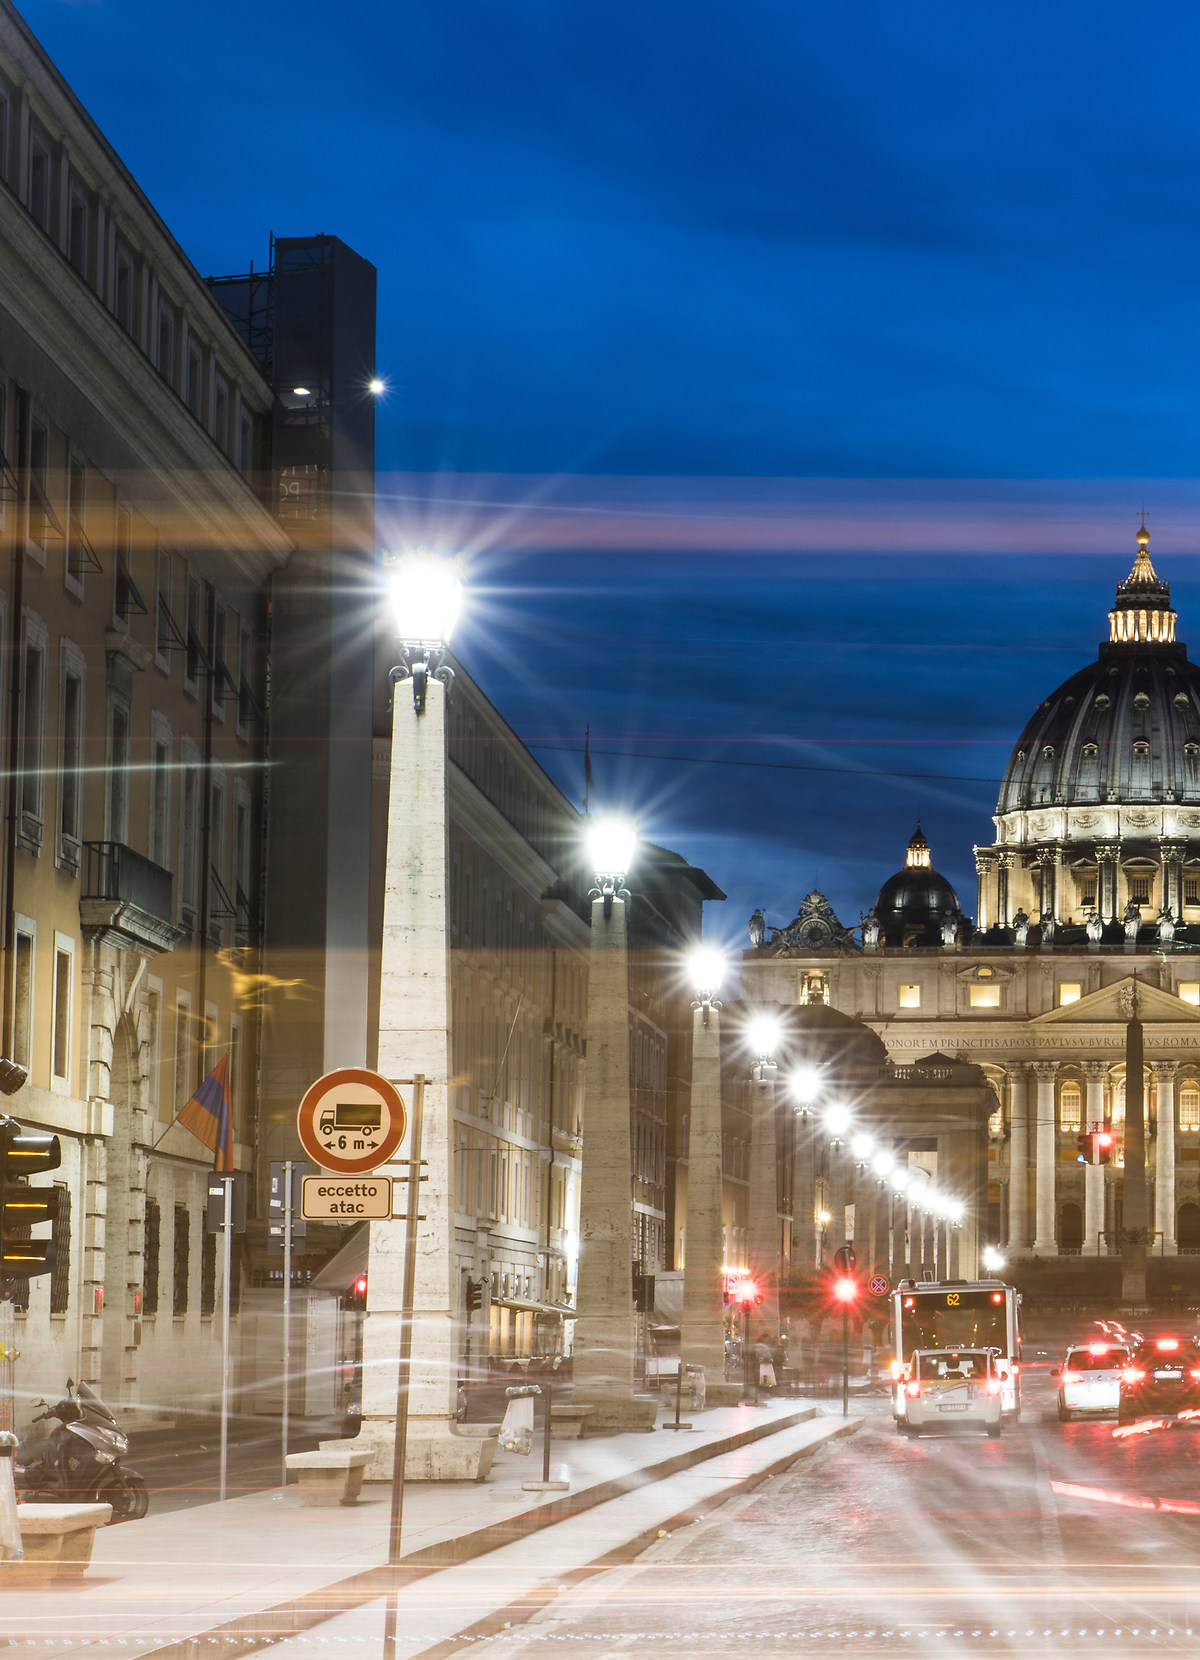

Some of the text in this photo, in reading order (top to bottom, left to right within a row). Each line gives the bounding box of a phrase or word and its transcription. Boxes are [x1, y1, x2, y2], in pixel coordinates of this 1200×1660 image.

[884, 1039, 938, 1048] ONOREM
[338, 1135, 364, 1150] 6 m
[318, 1184, 377, 1197] eccetto
[330, 1201, 364, 1213] atac
[946, 1293, 960, 1306] 62
